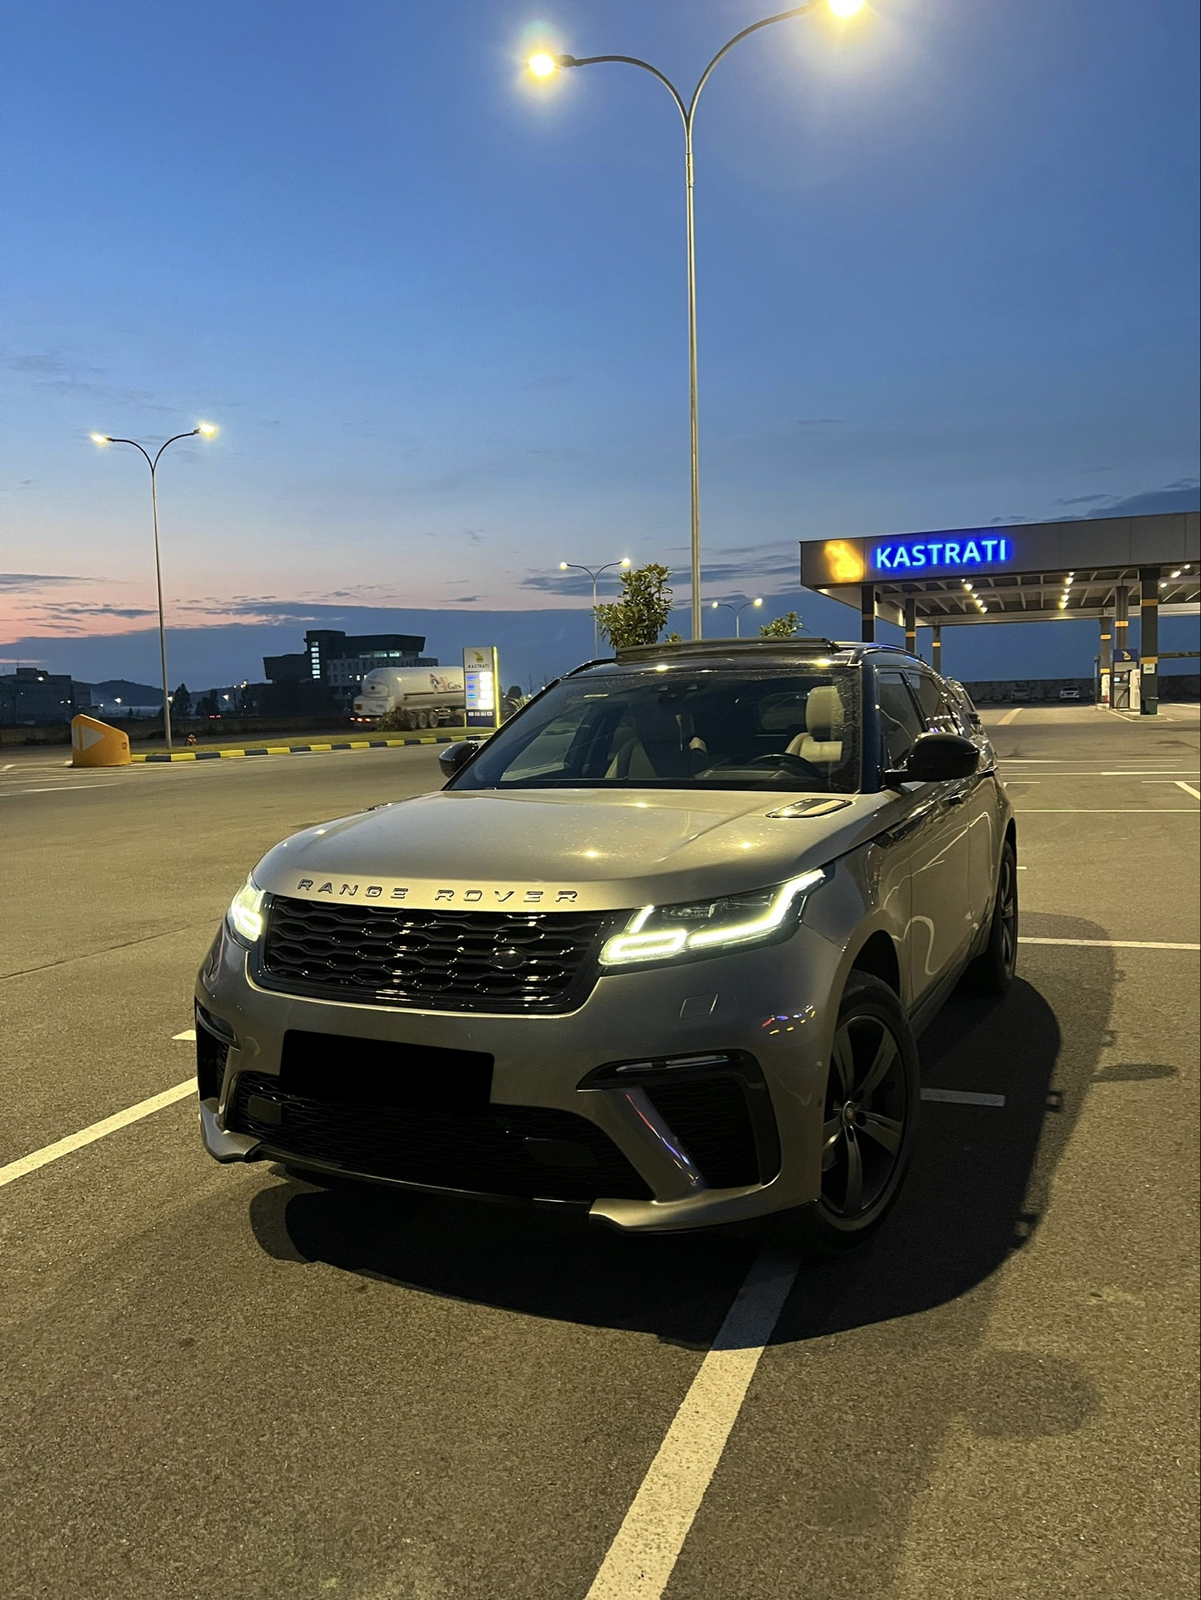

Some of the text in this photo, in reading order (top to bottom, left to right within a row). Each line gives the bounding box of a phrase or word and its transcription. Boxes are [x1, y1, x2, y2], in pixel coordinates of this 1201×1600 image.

[876, 539, 1006, 568] KASTRATI
[297, 878, 578, 903] RANGE ROVER
